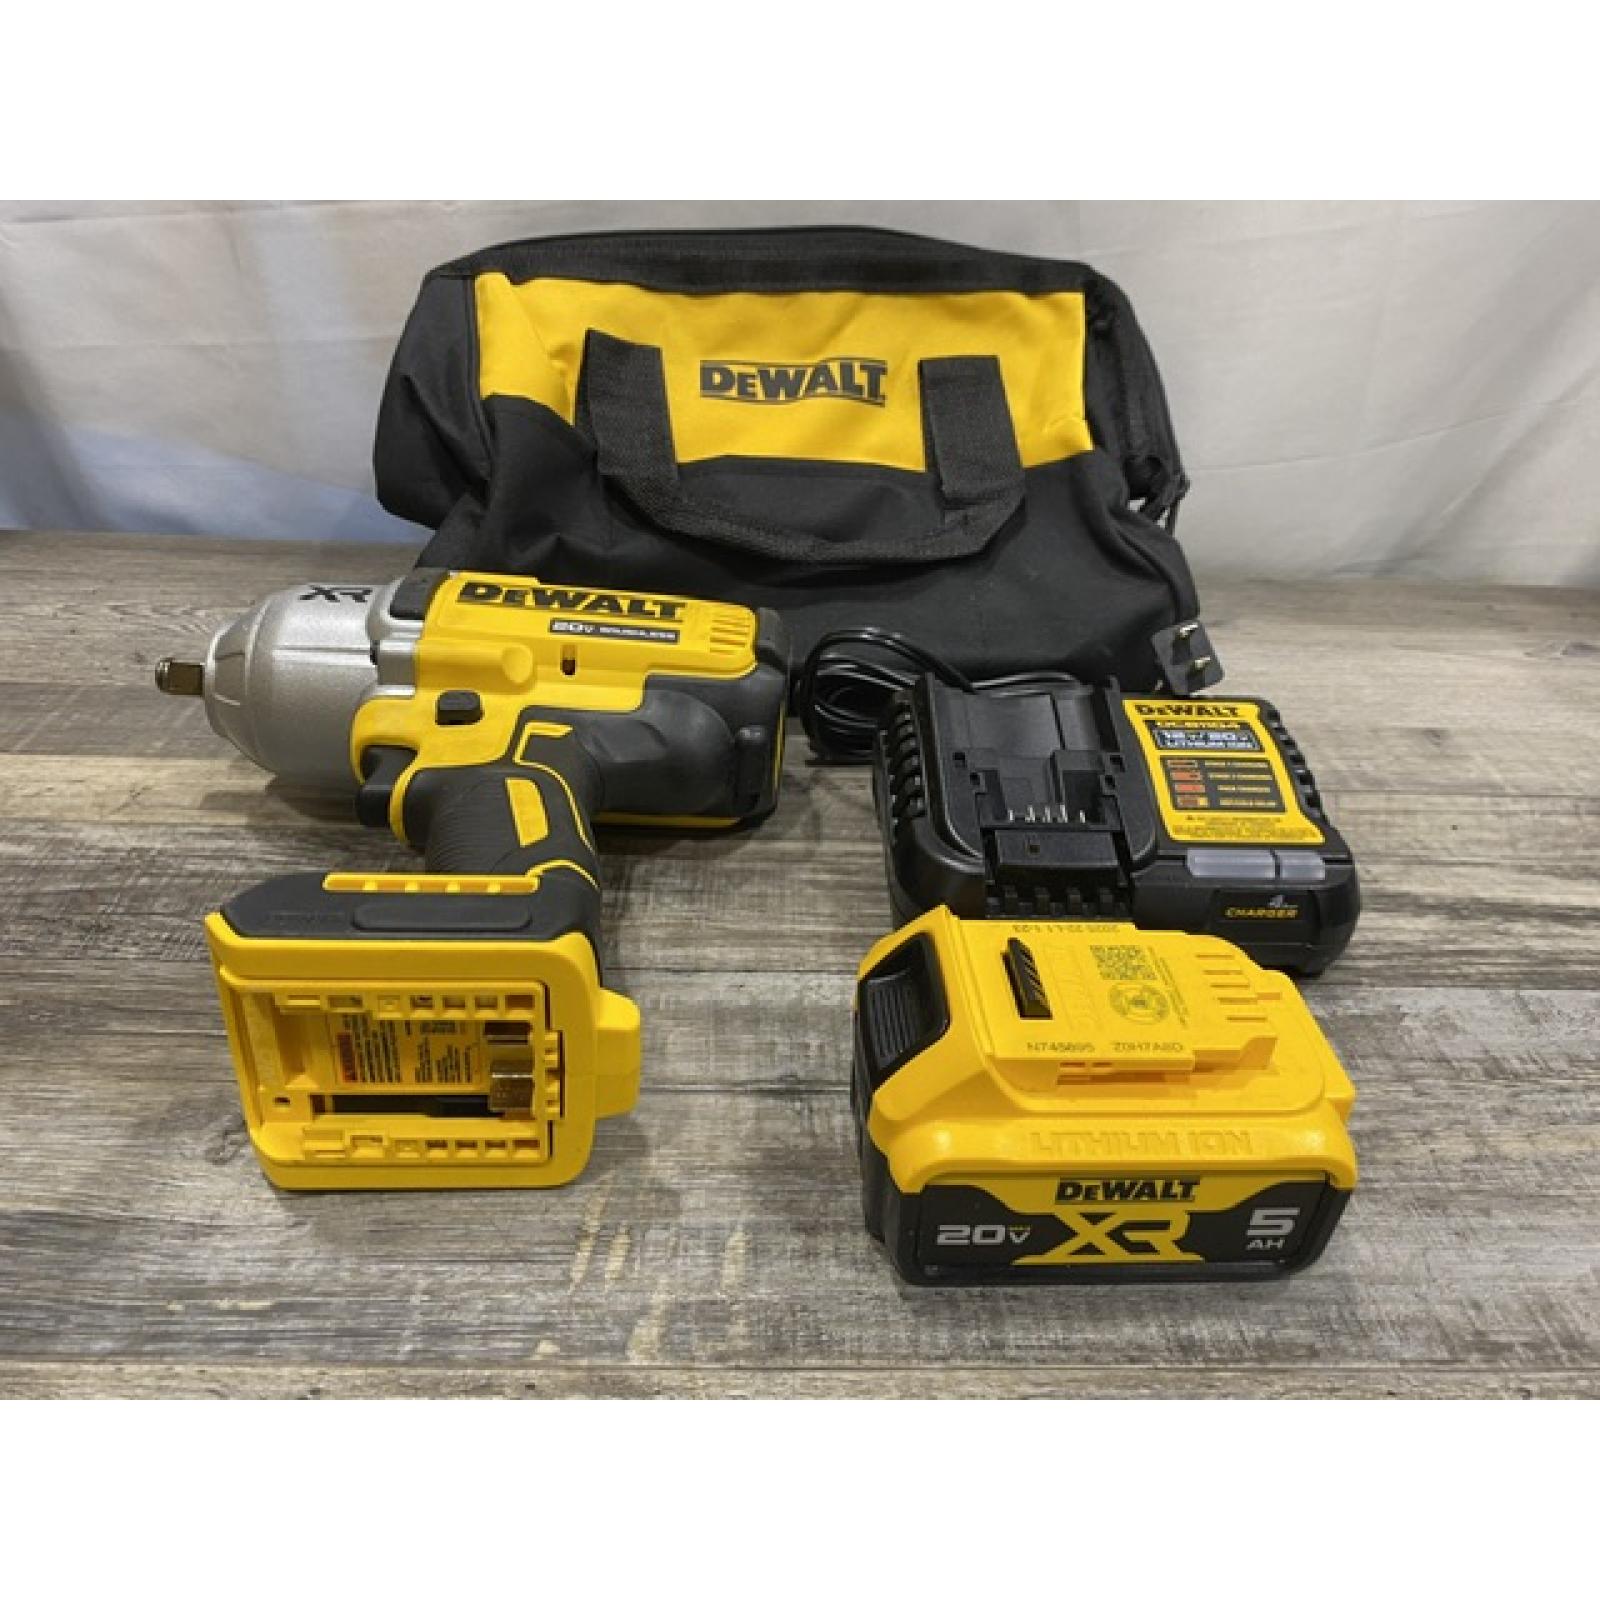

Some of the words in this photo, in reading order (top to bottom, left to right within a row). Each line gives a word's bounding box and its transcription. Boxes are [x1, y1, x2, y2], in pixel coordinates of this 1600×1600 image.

[700, 358, 888, 407] DEWALT
[457, 582, 687, 623] DEWALT
[1135, 704, 1239, 717] DEWALT
[1030, 1131, 1180, 1157] LITHIUM
[1188, 1131, 1252, 1156] ION
[1056, 1179, 1200, 1203] DEWALT
[1246, 1207, 1301, 1237] 5
[1010, 1208, 1205, 1265] XR
[1246, 1239, 1287, 1251] AH
